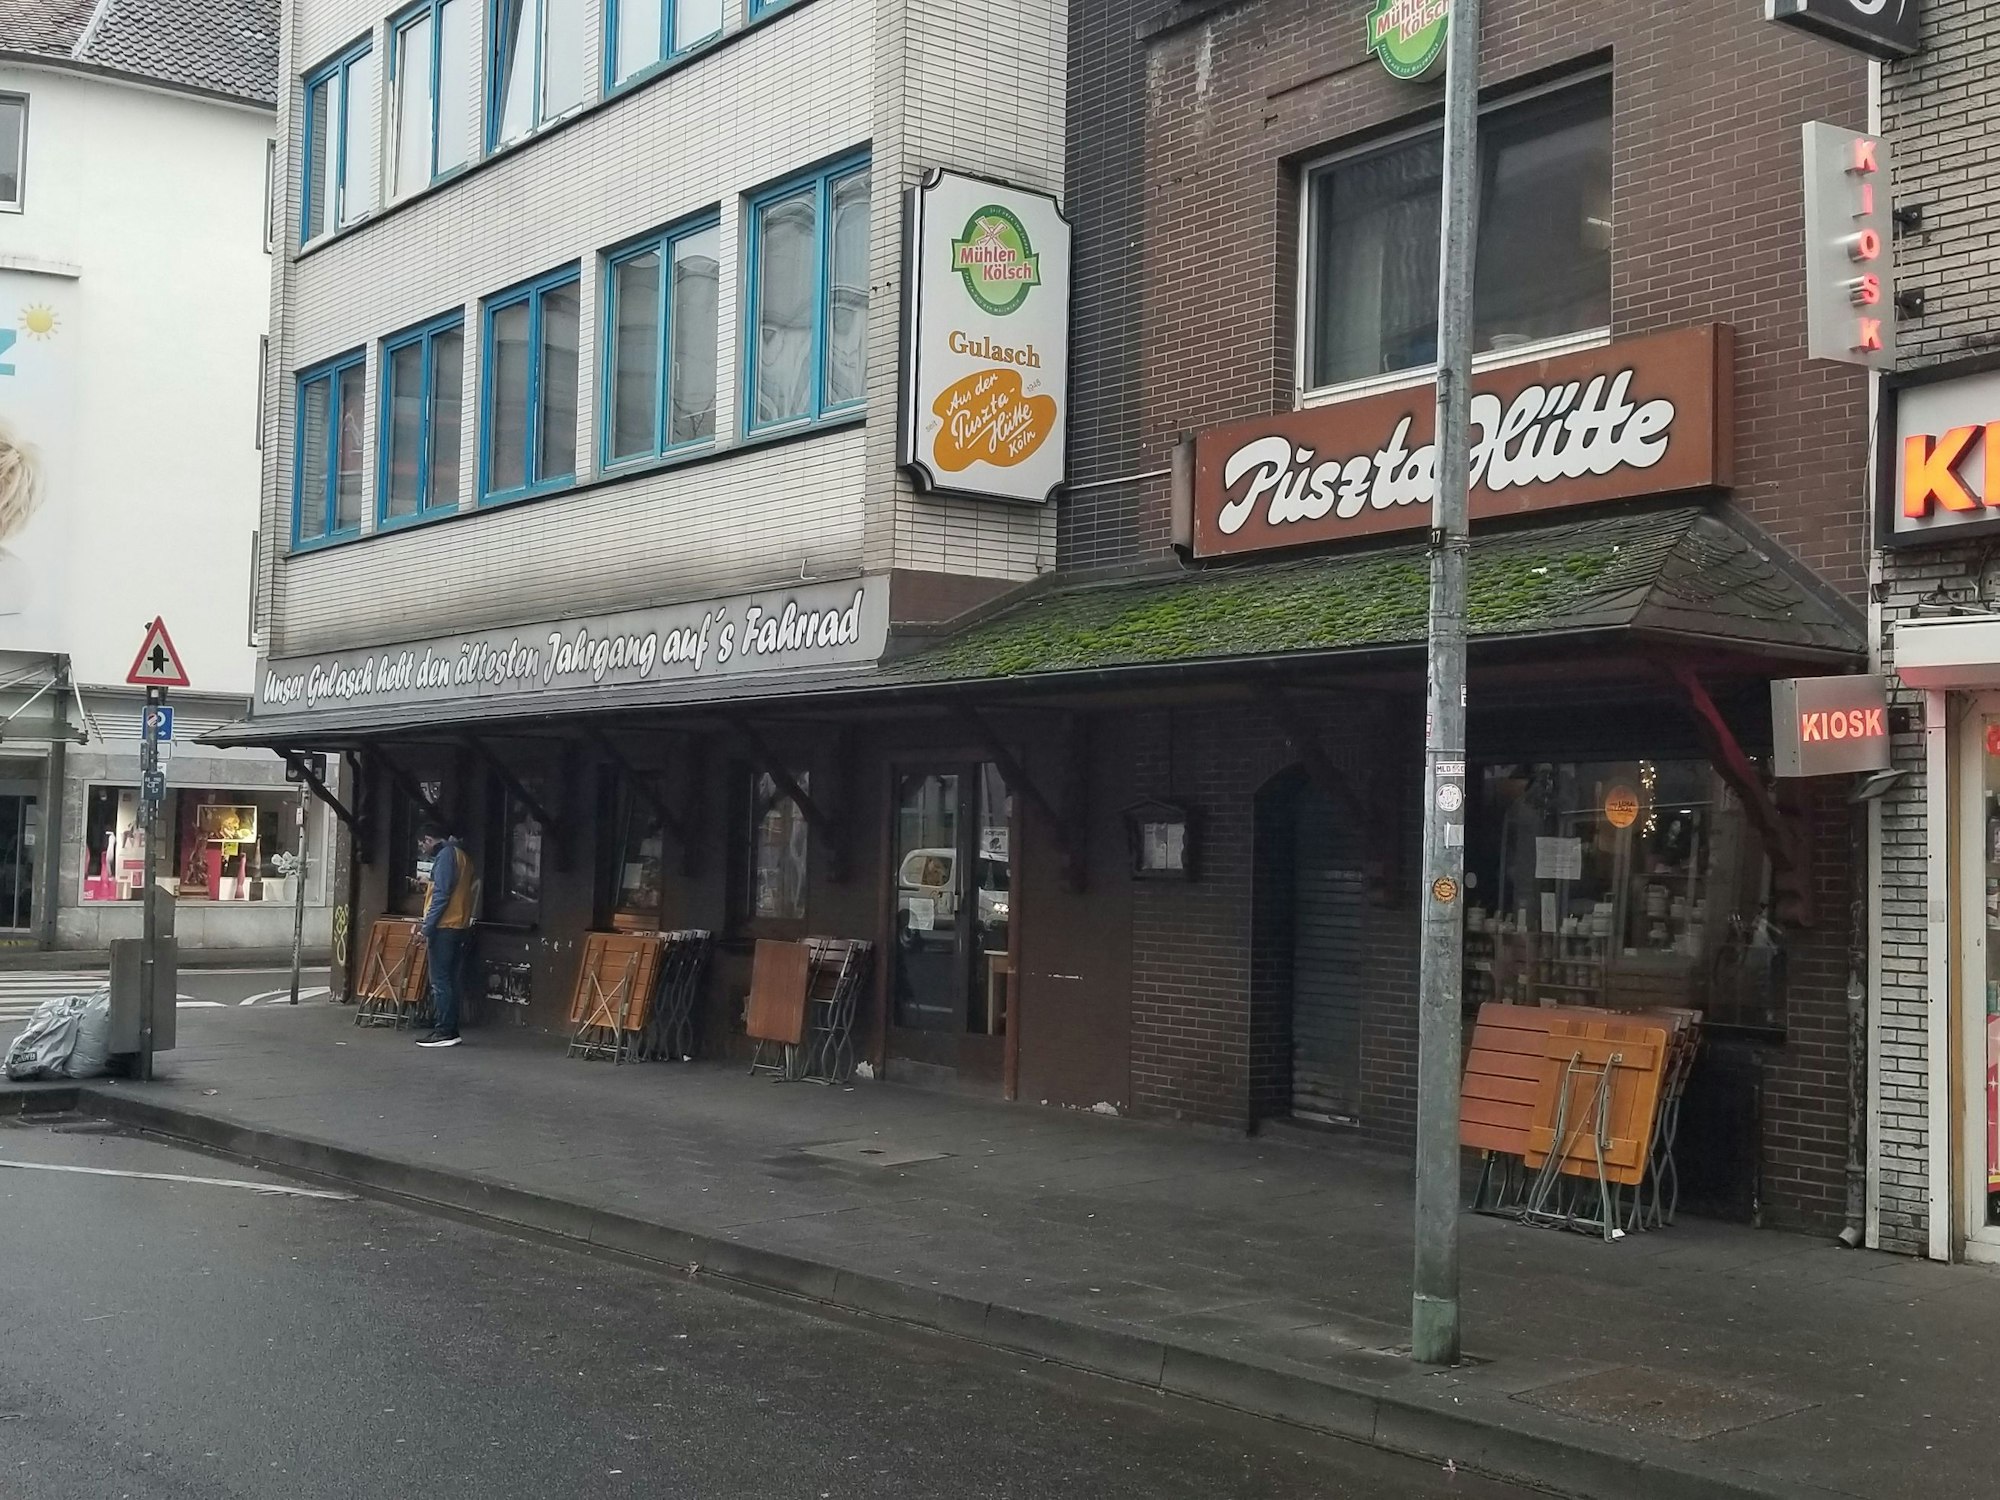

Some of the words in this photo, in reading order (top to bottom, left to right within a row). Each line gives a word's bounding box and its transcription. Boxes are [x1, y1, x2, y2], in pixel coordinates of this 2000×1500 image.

[1377, 0, 1430, 36] Mühle
[960, 246, 1016, 263] Mühlen
[1852, 138, 1882, 351] KIOSK
[983, 263, 1032, 280] Kölsch
[948, 330, 1041, 368] Gulasch
[946, 391, 972, 416] Aus
[975, 373, 998, 395] der
[988, 402, 1032, 453] Hütte
[1009, 431, 1036, 457] Köln
[1431, 531, 1441, 543] 17
[263, 669, 305, 706] Unser
[307, 657, 373, 707] Gulasch
[376, 651, 415, 692] hebt
[416, 647, 451, 688] den
[454, 637, 539, 686] ältesten
[543, 627, 658, 684] Jahrgang
[741, 588, 865, 655] Fahrrad
[1803, 708, 1883, 742] KIOSK
